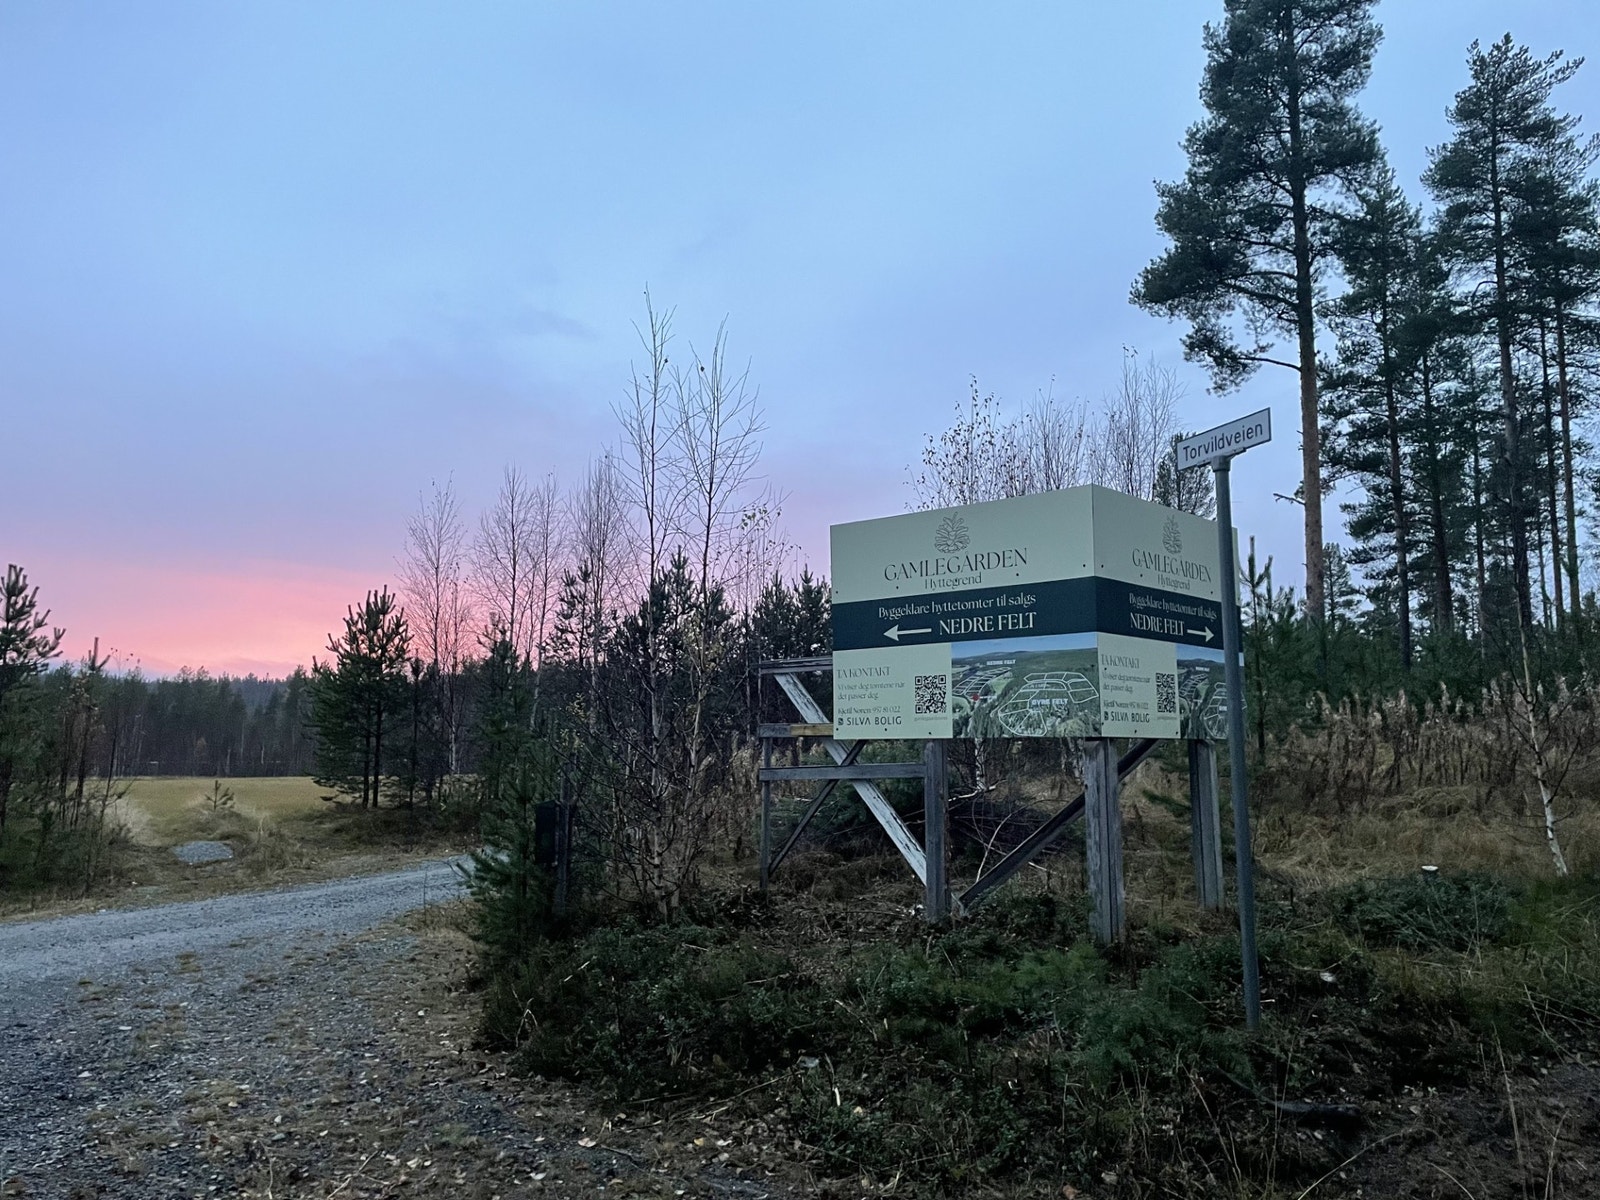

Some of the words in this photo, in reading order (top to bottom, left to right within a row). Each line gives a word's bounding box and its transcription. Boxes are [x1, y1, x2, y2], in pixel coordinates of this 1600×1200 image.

[1183, 423, 1263, 462] Torvildveien
[924, 571, 982, 591] Hyttegrend
[878, 603, 930, 620] Byggeklare
[931, 599, 994, 615] hyttetomter
[996, 593, 1007, 607] til
[1008, 591, 1037, 608] salgs
[1129, 592, 1162, 610] Byggeklare
[1162, 598, 1197, 615] hyttetomter
[1203, 606, 1217, 622] salgs
[939, 615, 995, 636] NEDRE
[998, 611, 1037, 631] FELT
[1130, 612, 1163, 633] NEDRE
[1164, 618, 1185, 636] FELT
[849, 666, 890, 678] KONTAKT
[846, 716, 871, 726] SILVA
[874, 715, 902, 726] BOLIG
[1110, 710, 1129, 722] SILVA
[1131, 712, 1150, 723] BOLIG
